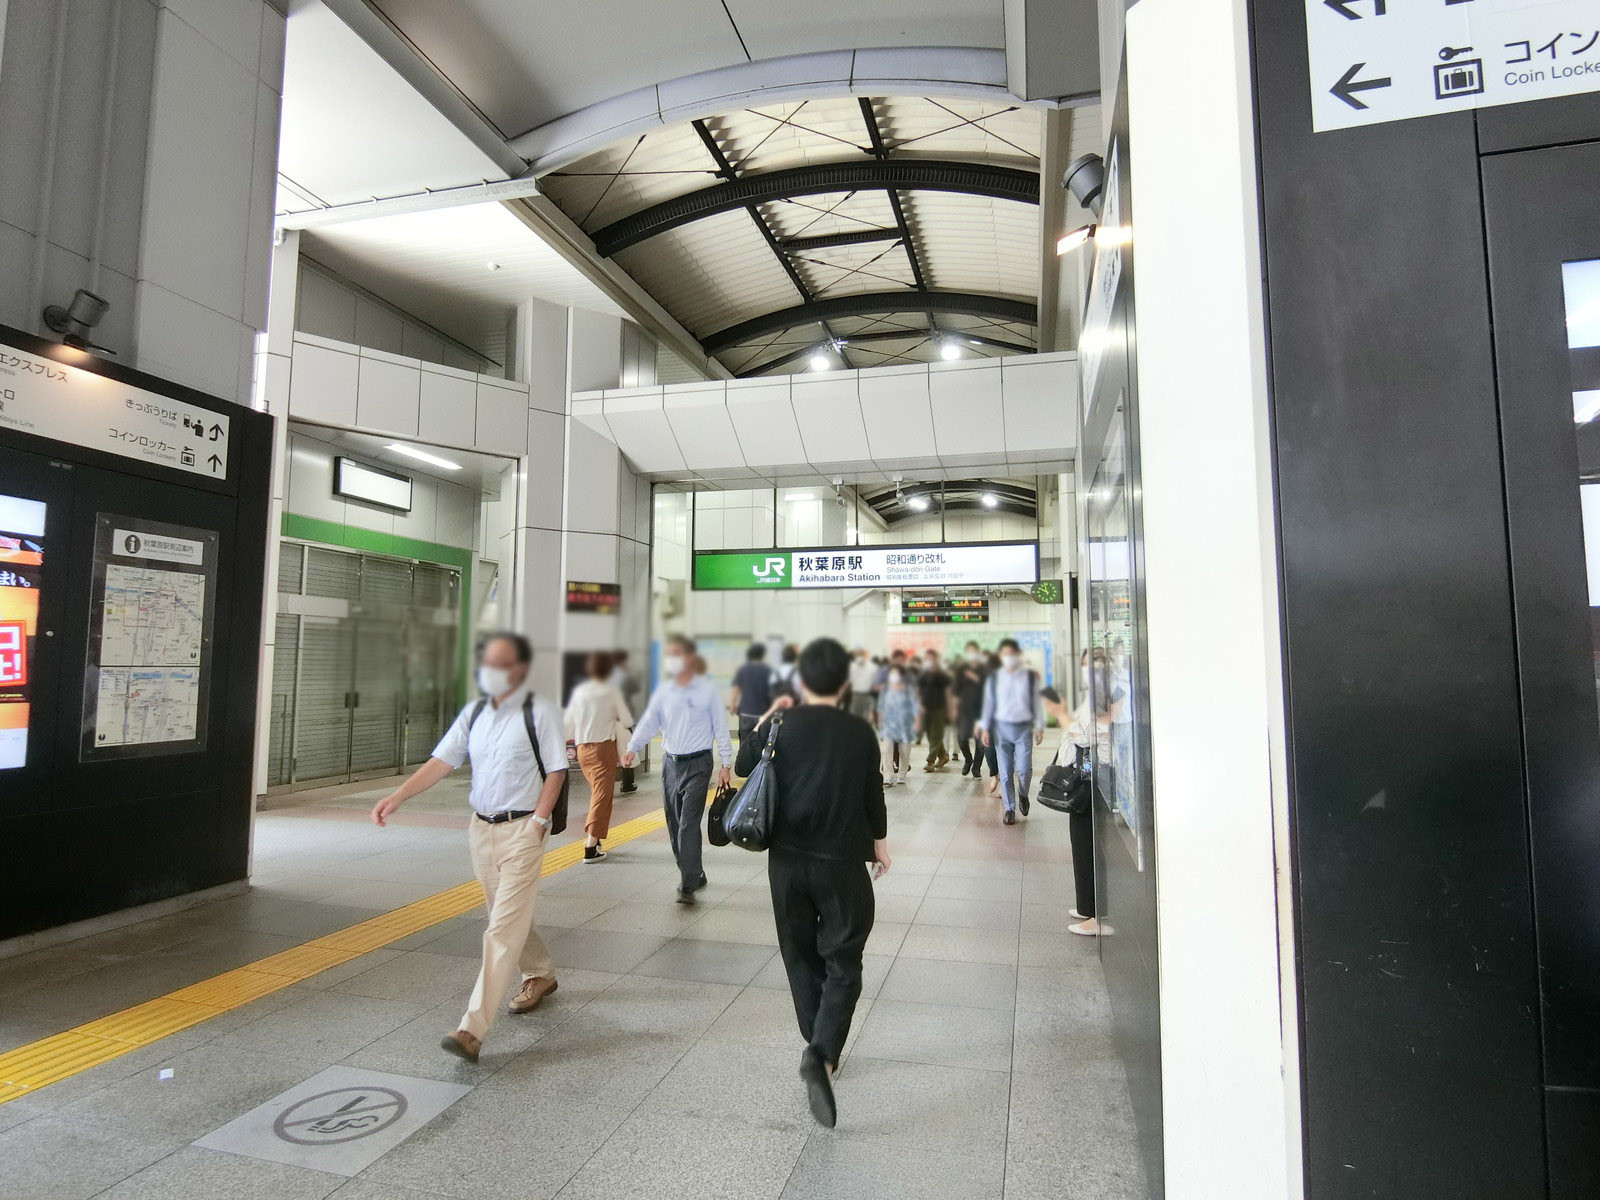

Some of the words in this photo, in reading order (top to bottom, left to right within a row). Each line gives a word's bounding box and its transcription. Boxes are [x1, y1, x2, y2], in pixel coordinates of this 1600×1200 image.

[1504, 30, 1600, 64] コイン
[1504, 70, 1545, 86] Coin
[126, 399, 178, 420] きっぷうりば
[109, 428, 176, 451] コインロッカー
[143, 448, 155, 456] Coin
[799, 556, 863, 571] 秋葉原駅
[886, 553, 946, 565] 昭和通り改札
[752, 557, 786, 577] JR
[924, 565, 941, 573] Gate
[800, 574, 845, 583] Akihabara
[847, 573, 881, 582] Station
